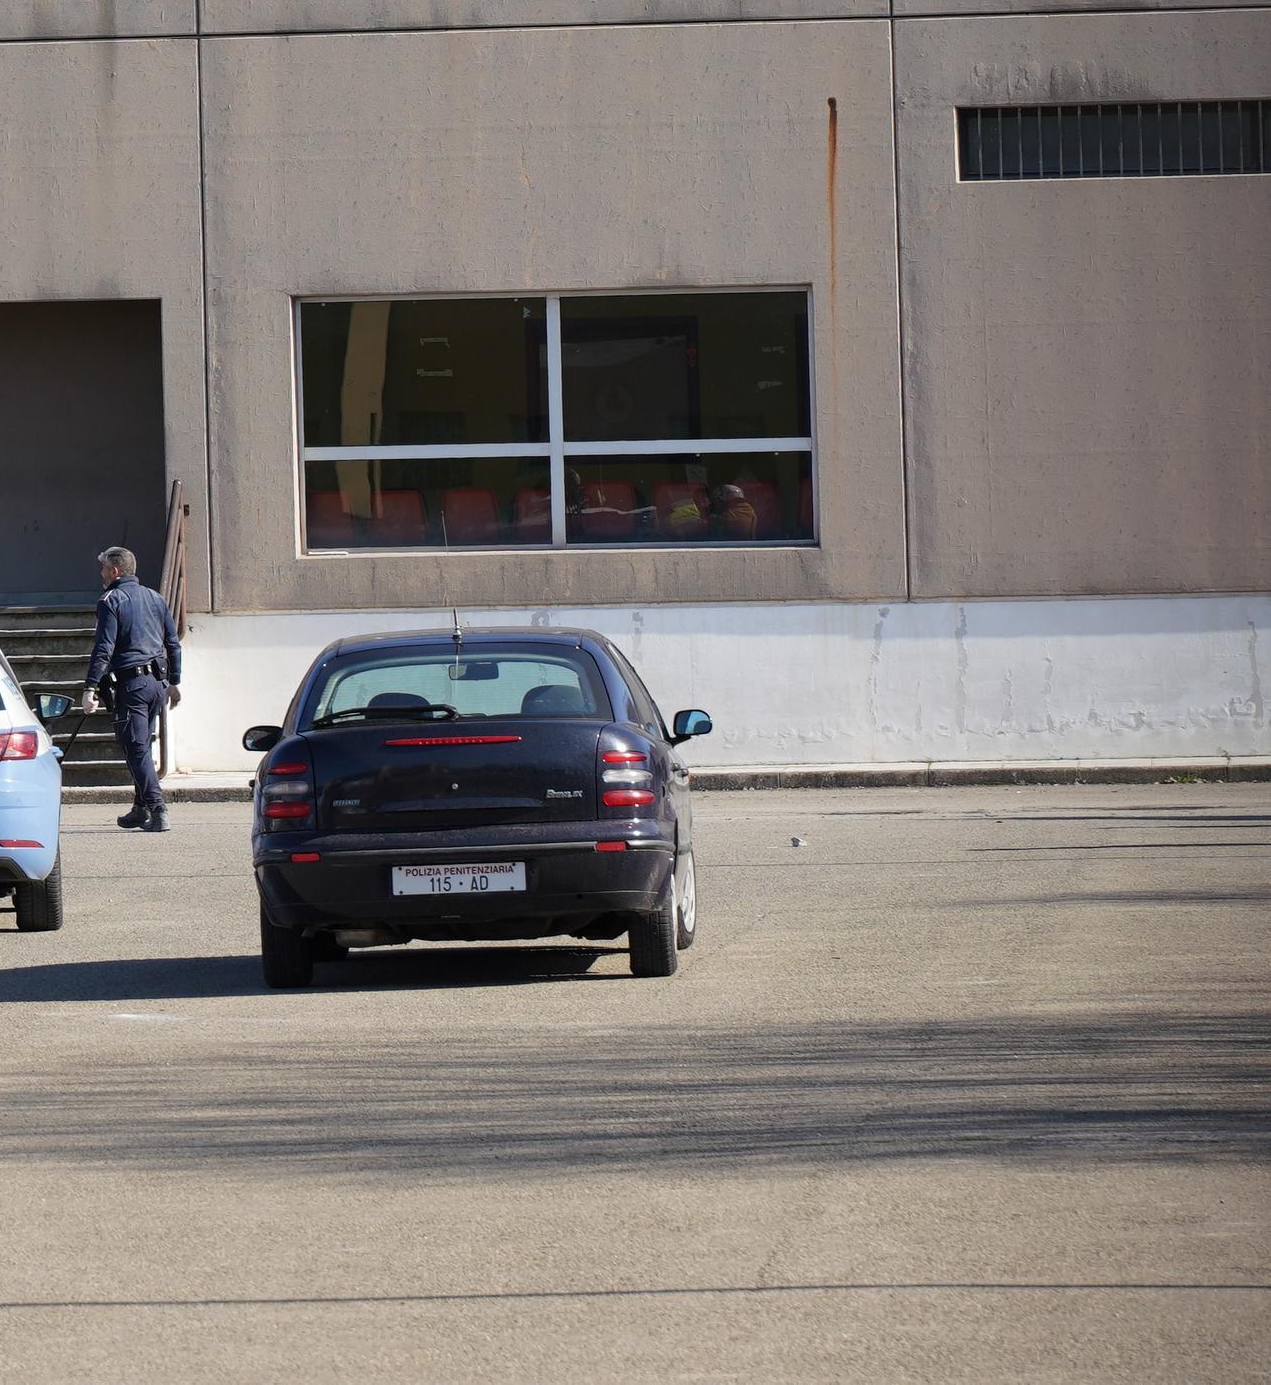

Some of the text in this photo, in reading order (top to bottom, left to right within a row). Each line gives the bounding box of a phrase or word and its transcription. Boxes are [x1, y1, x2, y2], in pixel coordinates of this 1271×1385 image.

[405, 865, 515, 877] POLIZIA PENITENZIARIA
[429, 875, 489, 892] 115 AD
